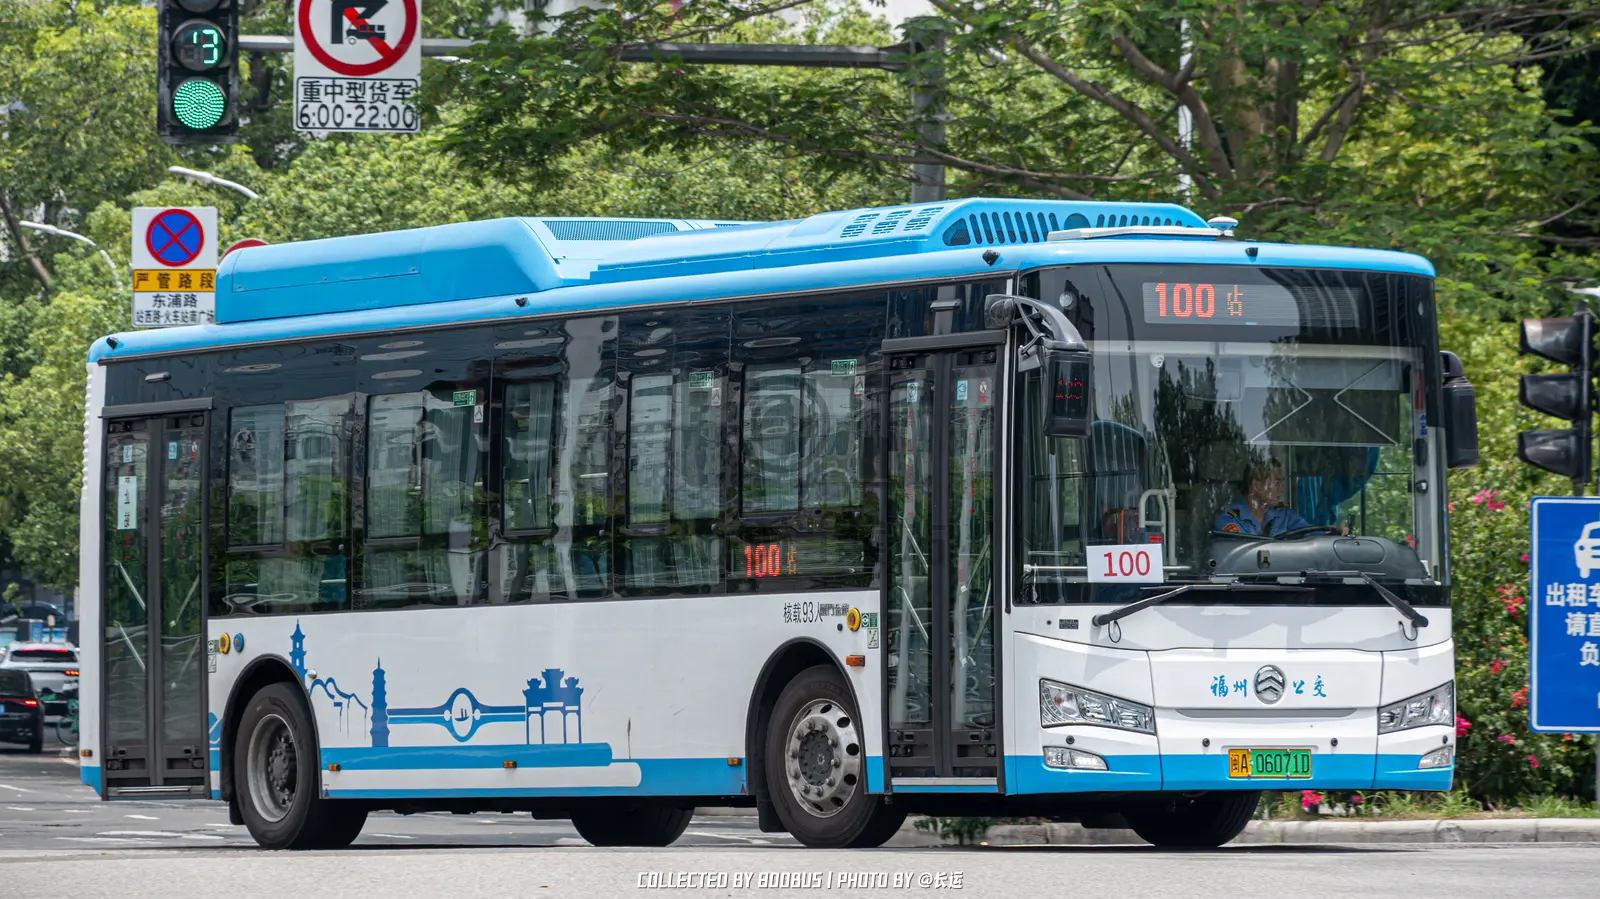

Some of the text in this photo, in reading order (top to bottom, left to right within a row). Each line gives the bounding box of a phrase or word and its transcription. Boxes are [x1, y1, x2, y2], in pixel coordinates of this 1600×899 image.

[301, 79, 413, 105] 重中型货车
[134, 272, 214, 289] 严管路段
[152, 293, 198, 308] 东浦路
[1155, 282, 1216, 318] 100
[743, 543, 781, 578] 100
[1103, 550, 1151, 577] 100
[1210, 675, 1248, 698] 福州
[1255, 753, 1310, 774] 06071D
